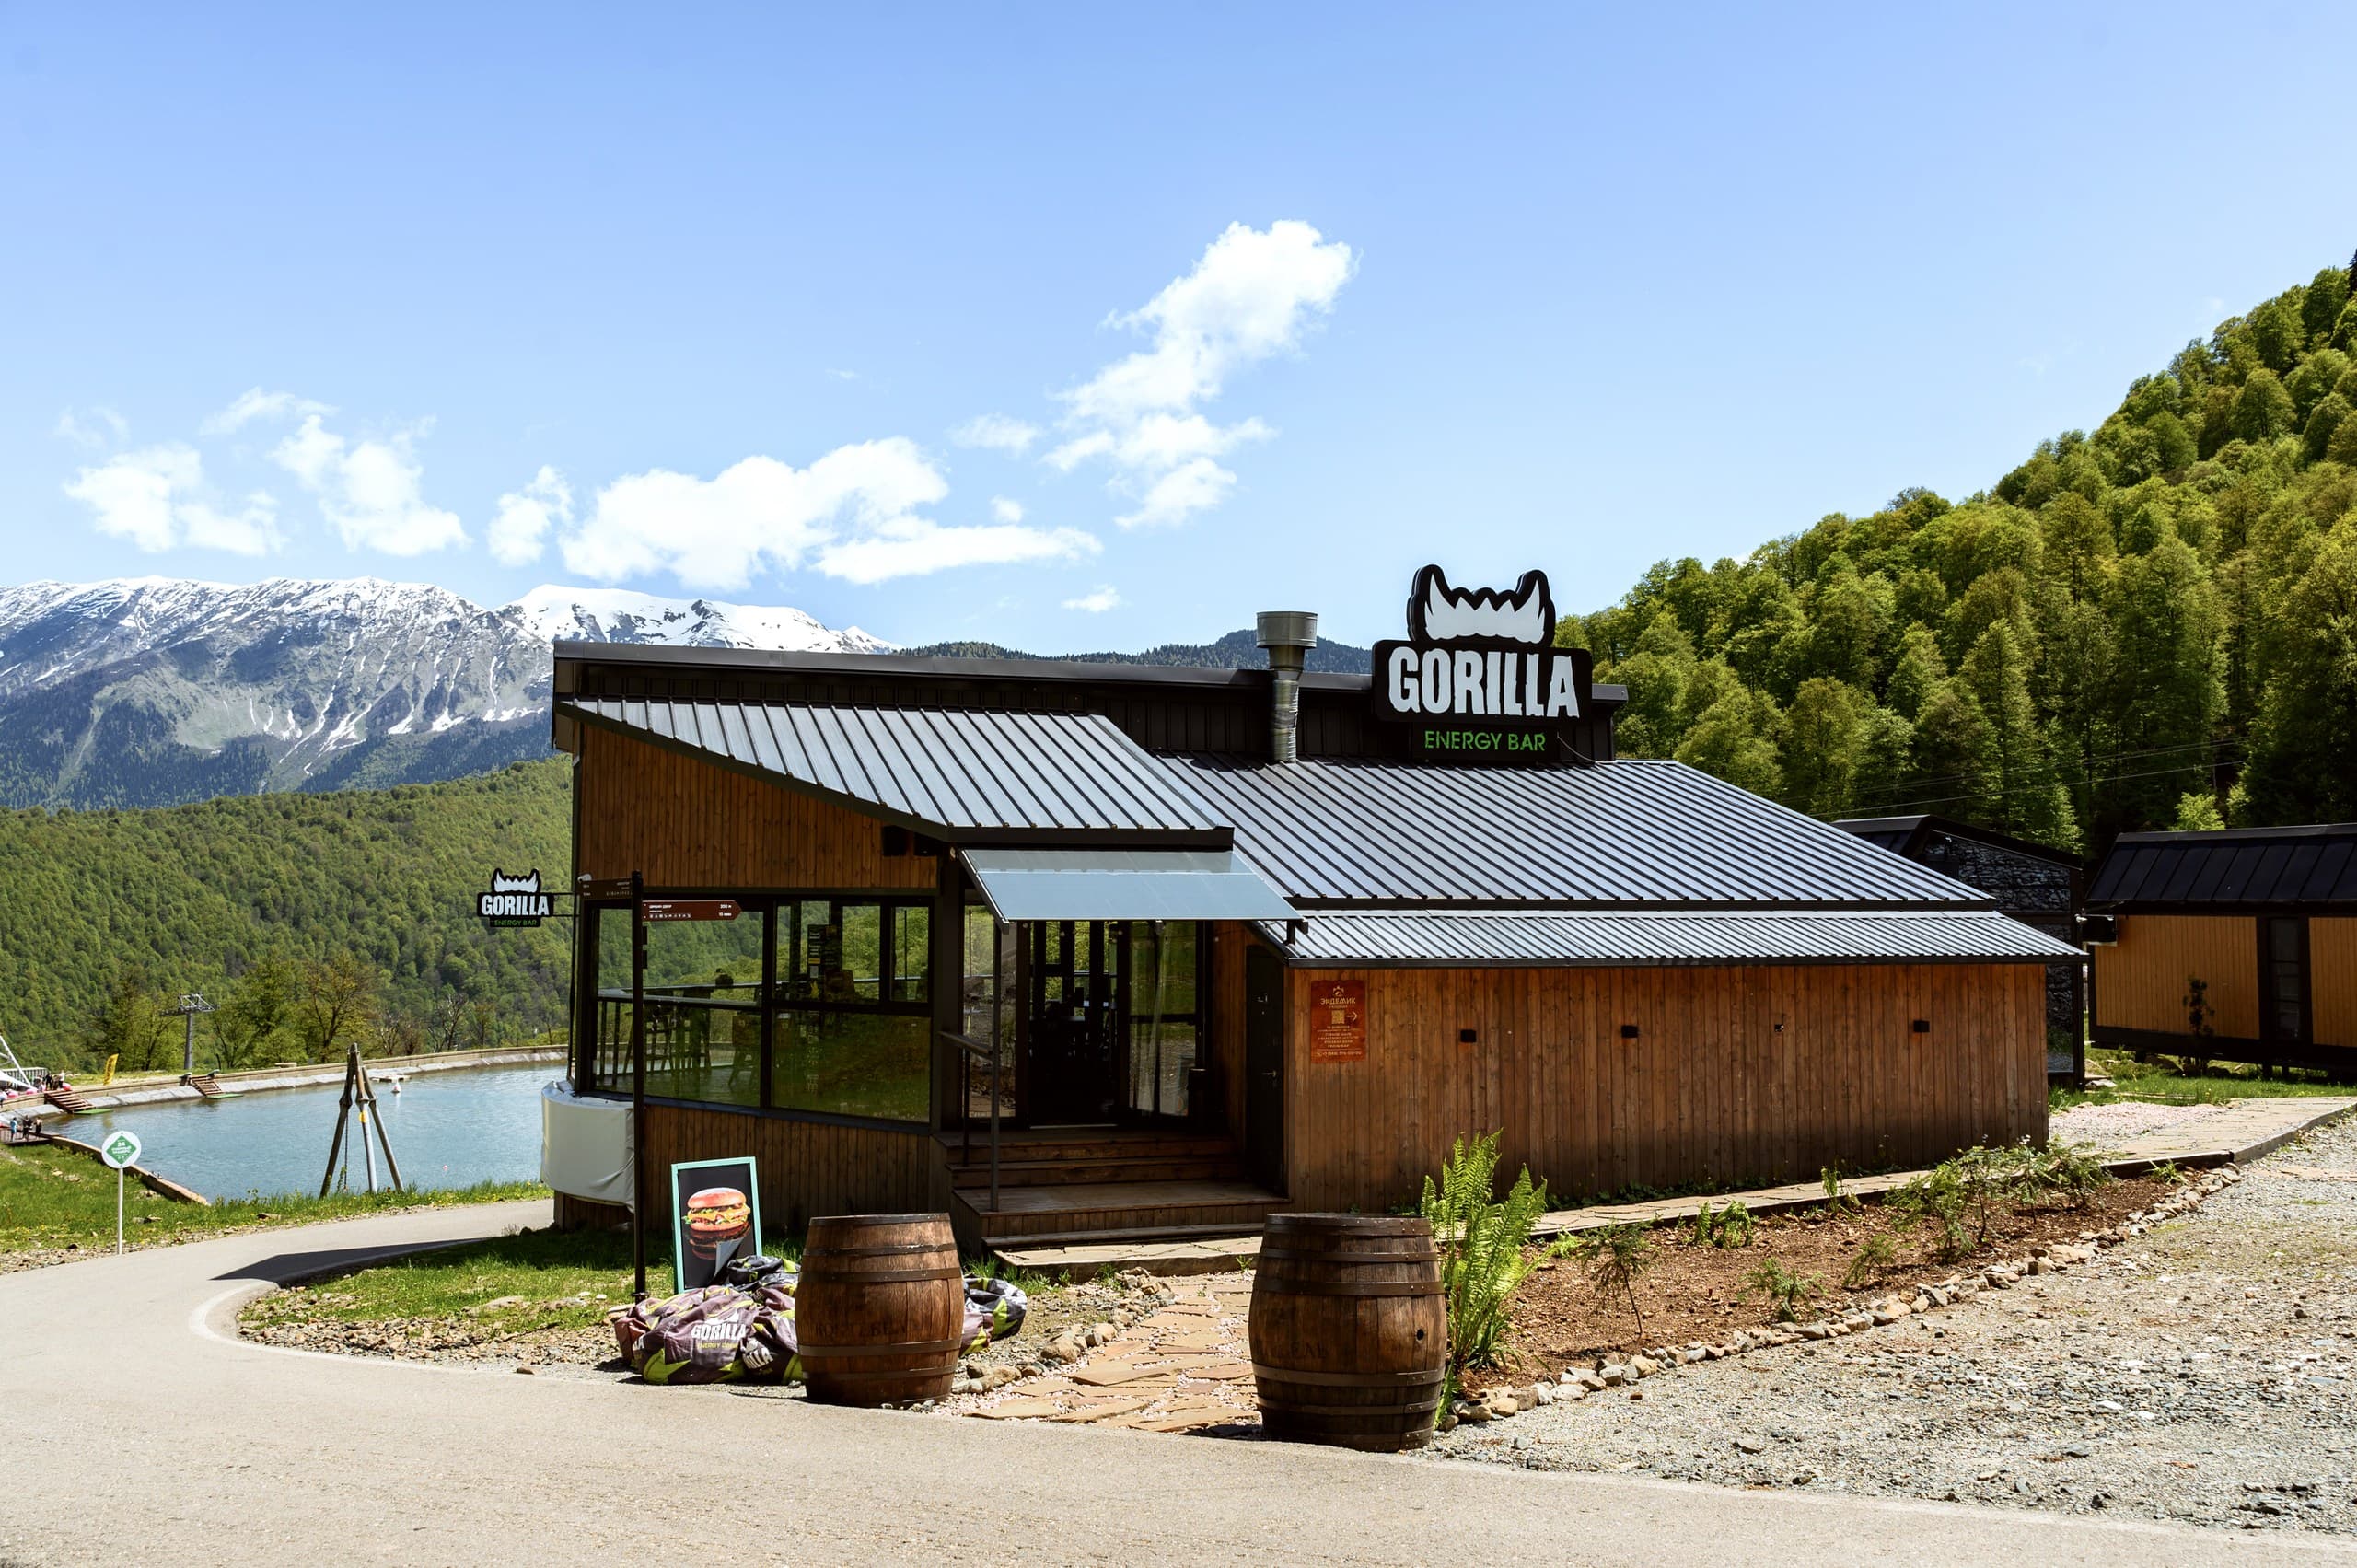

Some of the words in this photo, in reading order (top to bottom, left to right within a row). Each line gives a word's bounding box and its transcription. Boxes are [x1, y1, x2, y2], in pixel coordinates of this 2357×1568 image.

[1388, 646, 1580, 718] GORILLA
[1424, 730, 1503, 750] ENERGY
[1507, 733, 1546, 751] BAR
[481, 895, 550, 916] GORILLA
[691, 1322, 746, 1341] GORILLA
